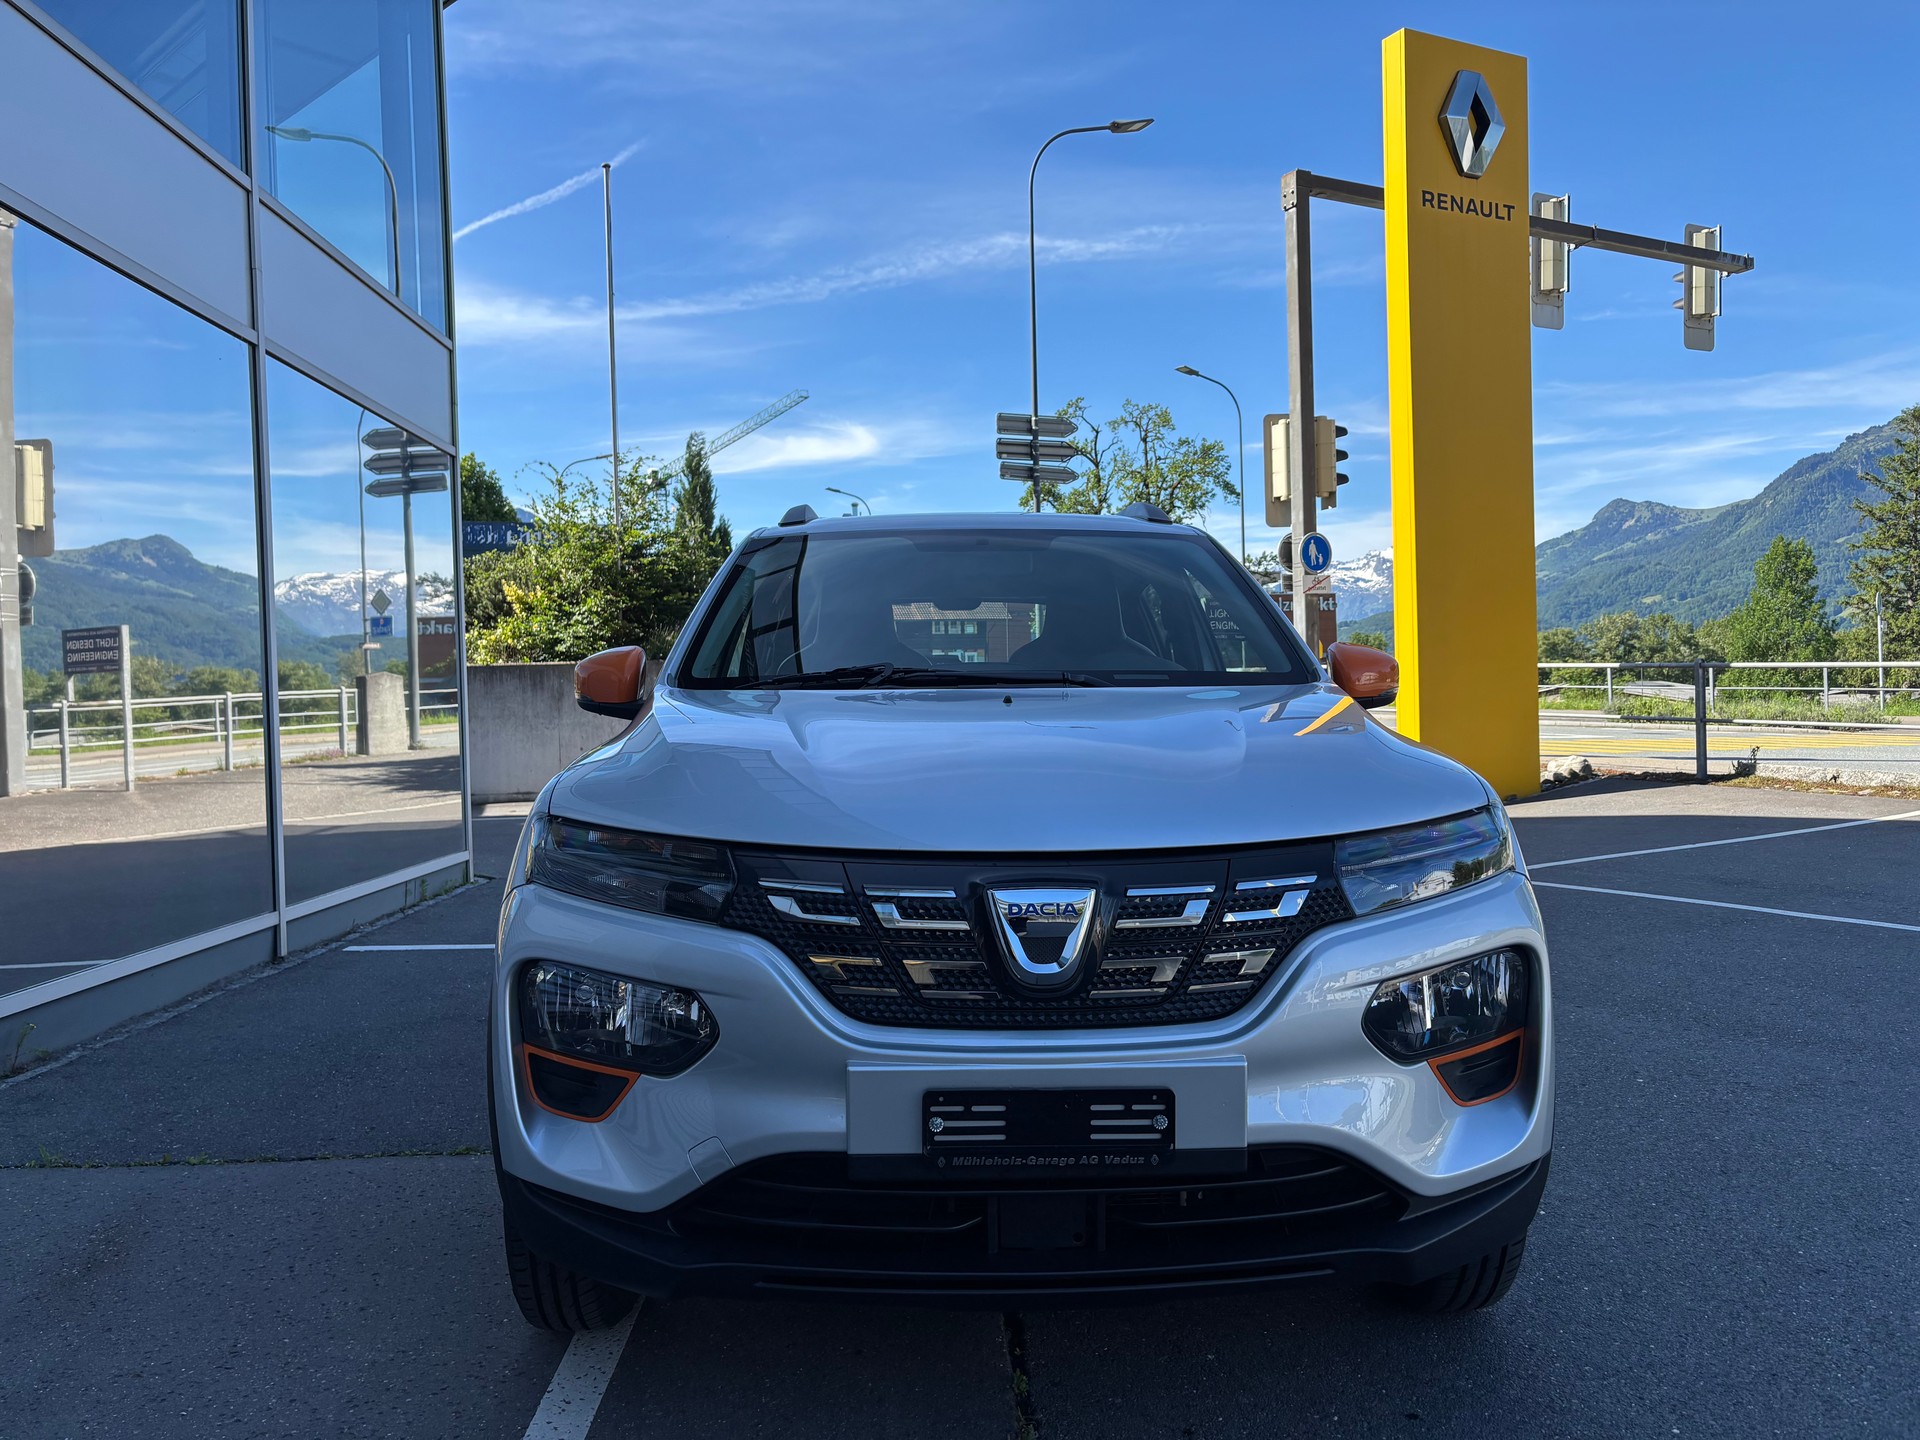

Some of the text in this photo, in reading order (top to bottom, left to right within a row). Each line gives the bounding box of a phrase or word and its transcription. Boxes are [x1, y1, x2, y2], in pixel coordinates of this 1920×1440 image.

[1421, 189, 1516, 222] RENAULT
[1007, 902, 1079, 917] DACIA
[952, 1154, 1145, 1167] Mühleholz-Garage AG Vaduz
